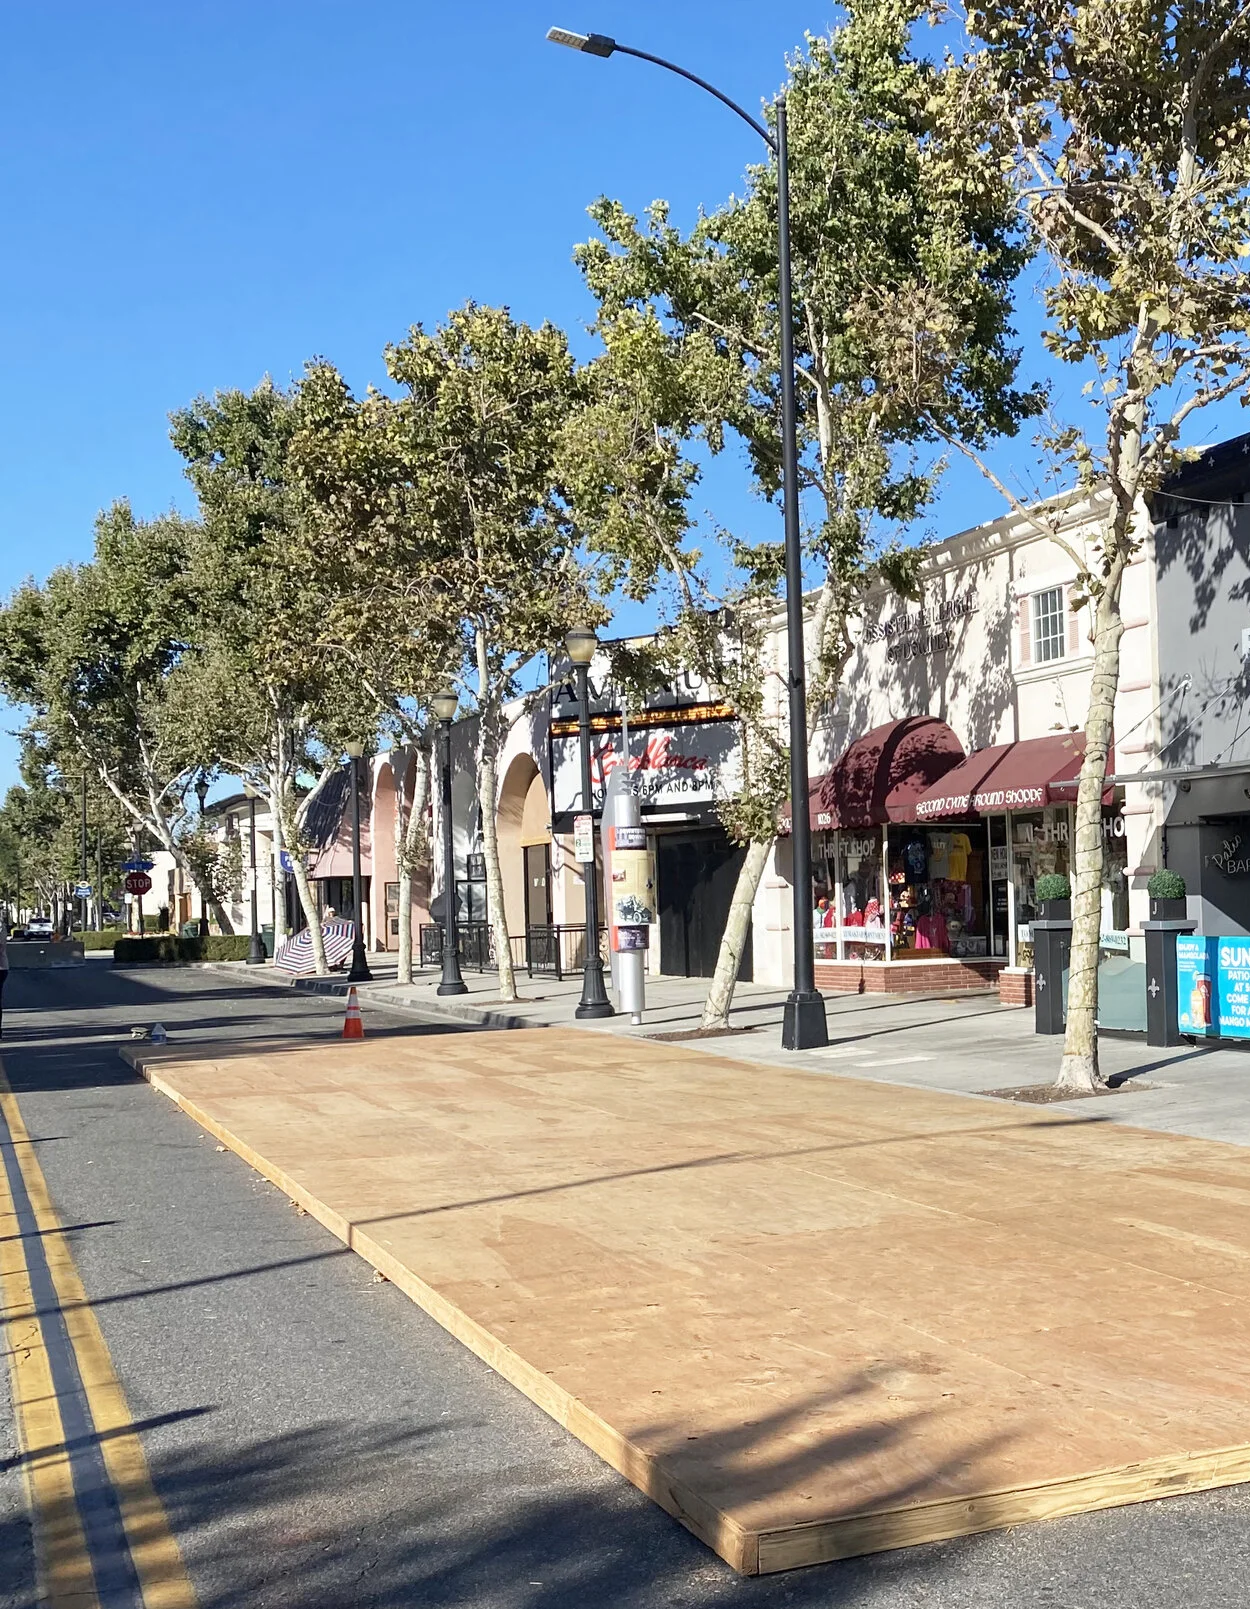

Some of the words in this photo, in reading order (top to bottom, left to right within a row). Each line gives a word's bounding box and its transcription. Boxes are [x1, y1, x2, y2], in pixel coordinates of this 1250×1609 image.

[590, 736, 708, 783] Caablanca
[642, 783, 663, 796] 6PM
[666, 781, 689, 793] AND
[692, 778, 714, 792] 8PM
[819, 841, 849, 859] THRFT
[851, 839, 875, 858] SHOP
[126, 879, 151, 889] STOP
[1228, 970, 1250, 980] PATIO
[1234, 982, 1245, 992] AT
[1226, 993, 1249, 1004] COME
[1231, 1005, 1247, 1015] FOR
